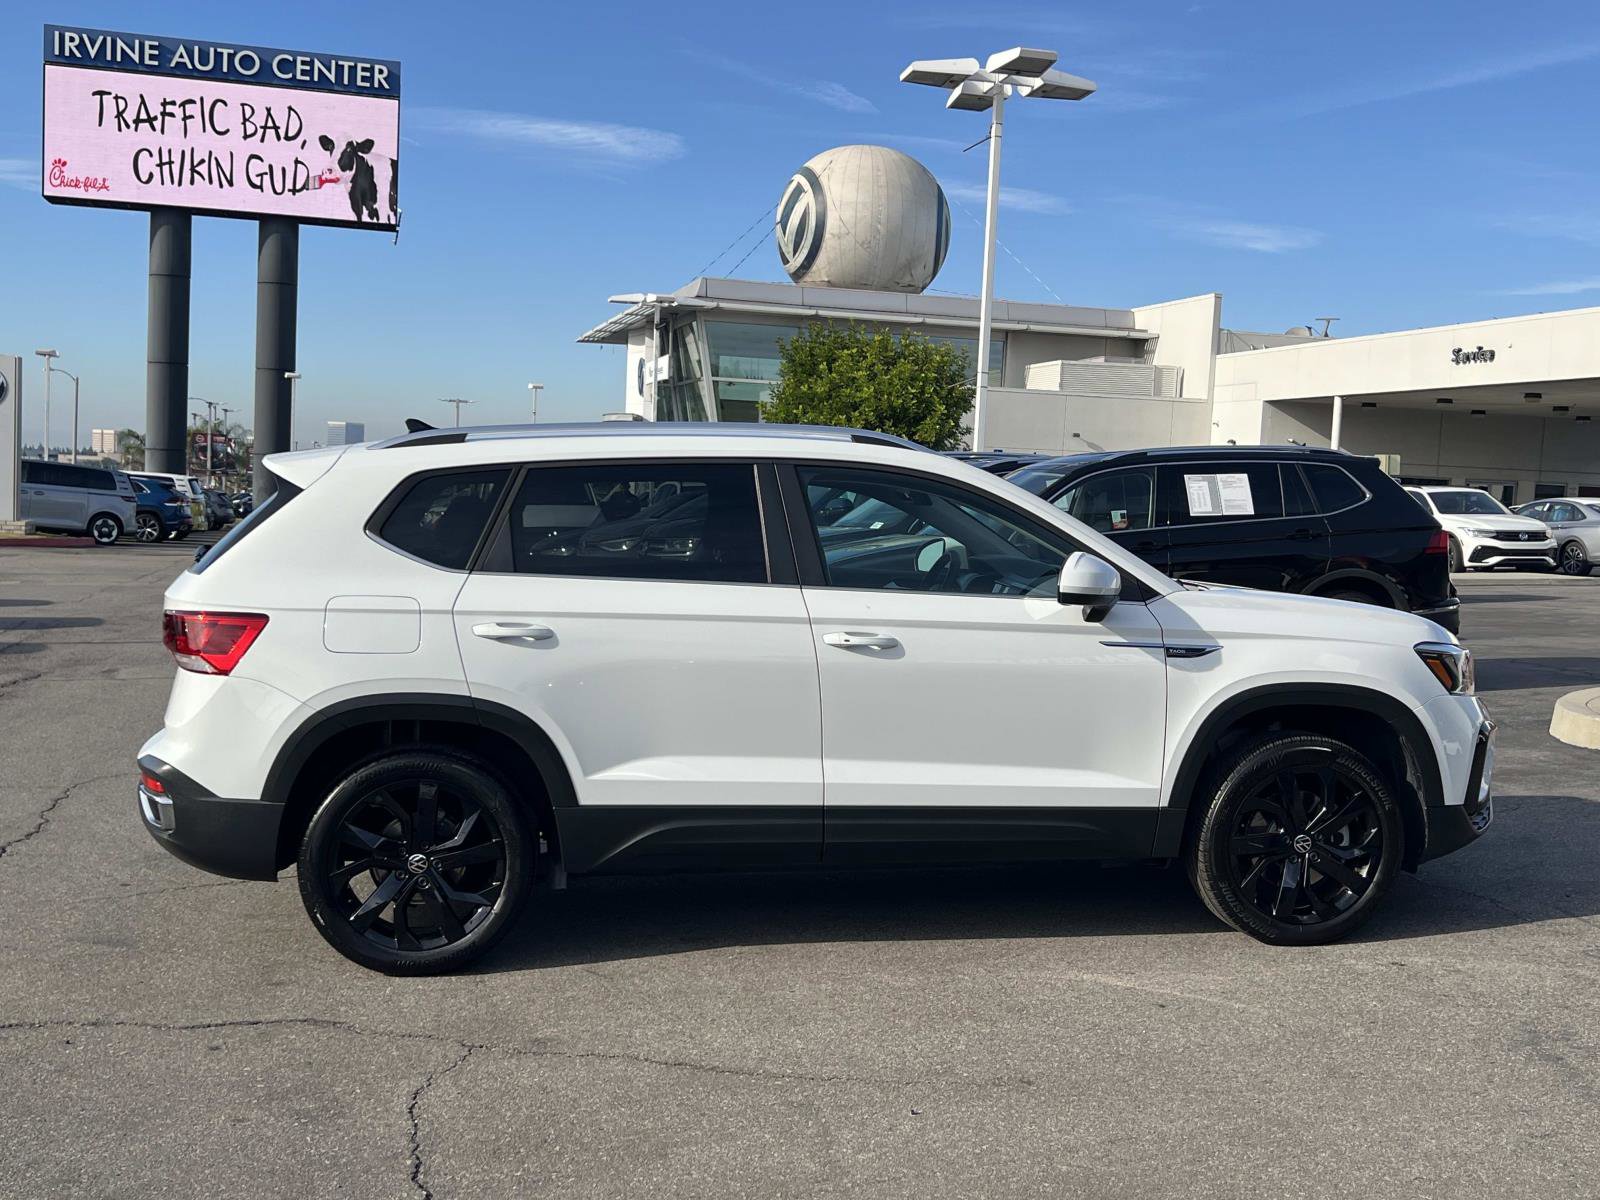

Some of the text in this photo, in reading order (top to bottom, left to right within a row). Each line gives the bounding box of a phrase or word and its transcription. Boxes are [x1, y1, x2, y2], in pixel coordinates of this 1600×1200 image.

[54, 31, 390, 89] IRVINE AUTO CENTER
[92, 89, 307, 150] TRAFFIC BAD,
[49, 158, 110, 192] Chick-fil-A
[132, 146, 310, 196] CHIKIN GUD
